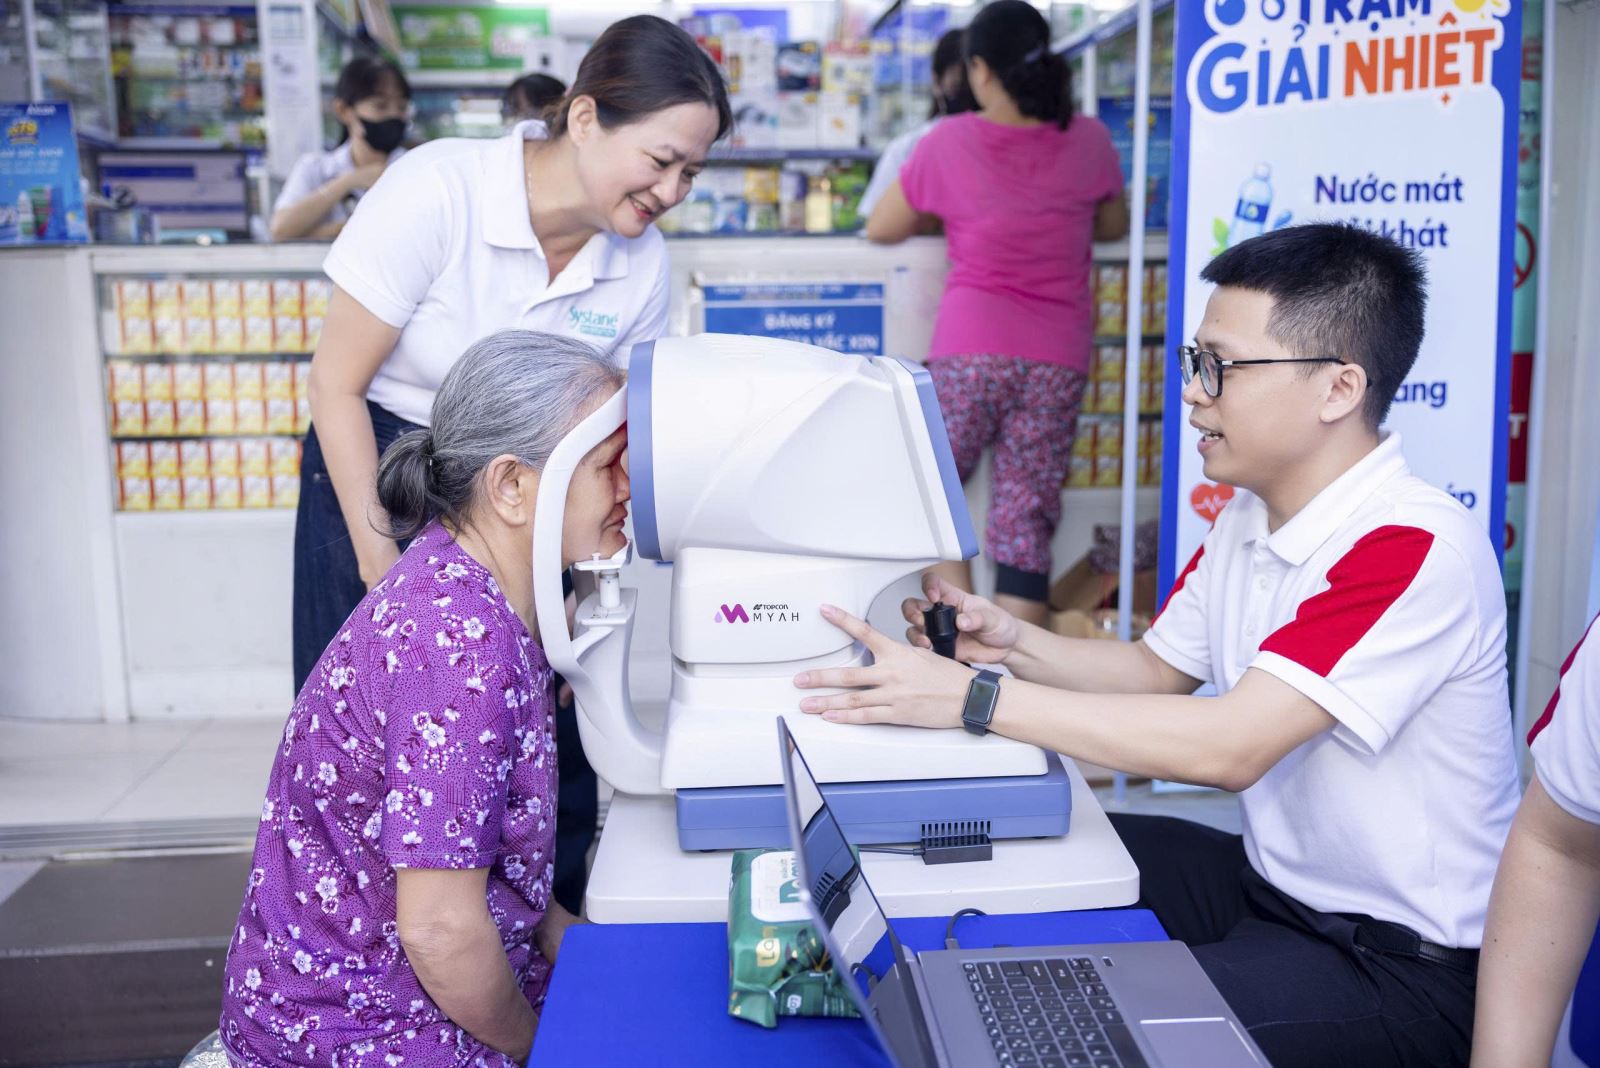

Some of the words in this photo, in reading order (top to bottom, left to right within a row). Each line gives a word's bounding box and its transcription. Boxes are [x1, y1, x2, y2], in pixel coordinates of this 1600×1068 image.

[1197, 23, 1330, 113] GIẢI
[1344, 11, 1496, 105] NHIỆT
[1315, 173, 1396, 203] Nước
[1406, 172, 1463, 202] mát
[753, 612, 799, 622] MYAH
